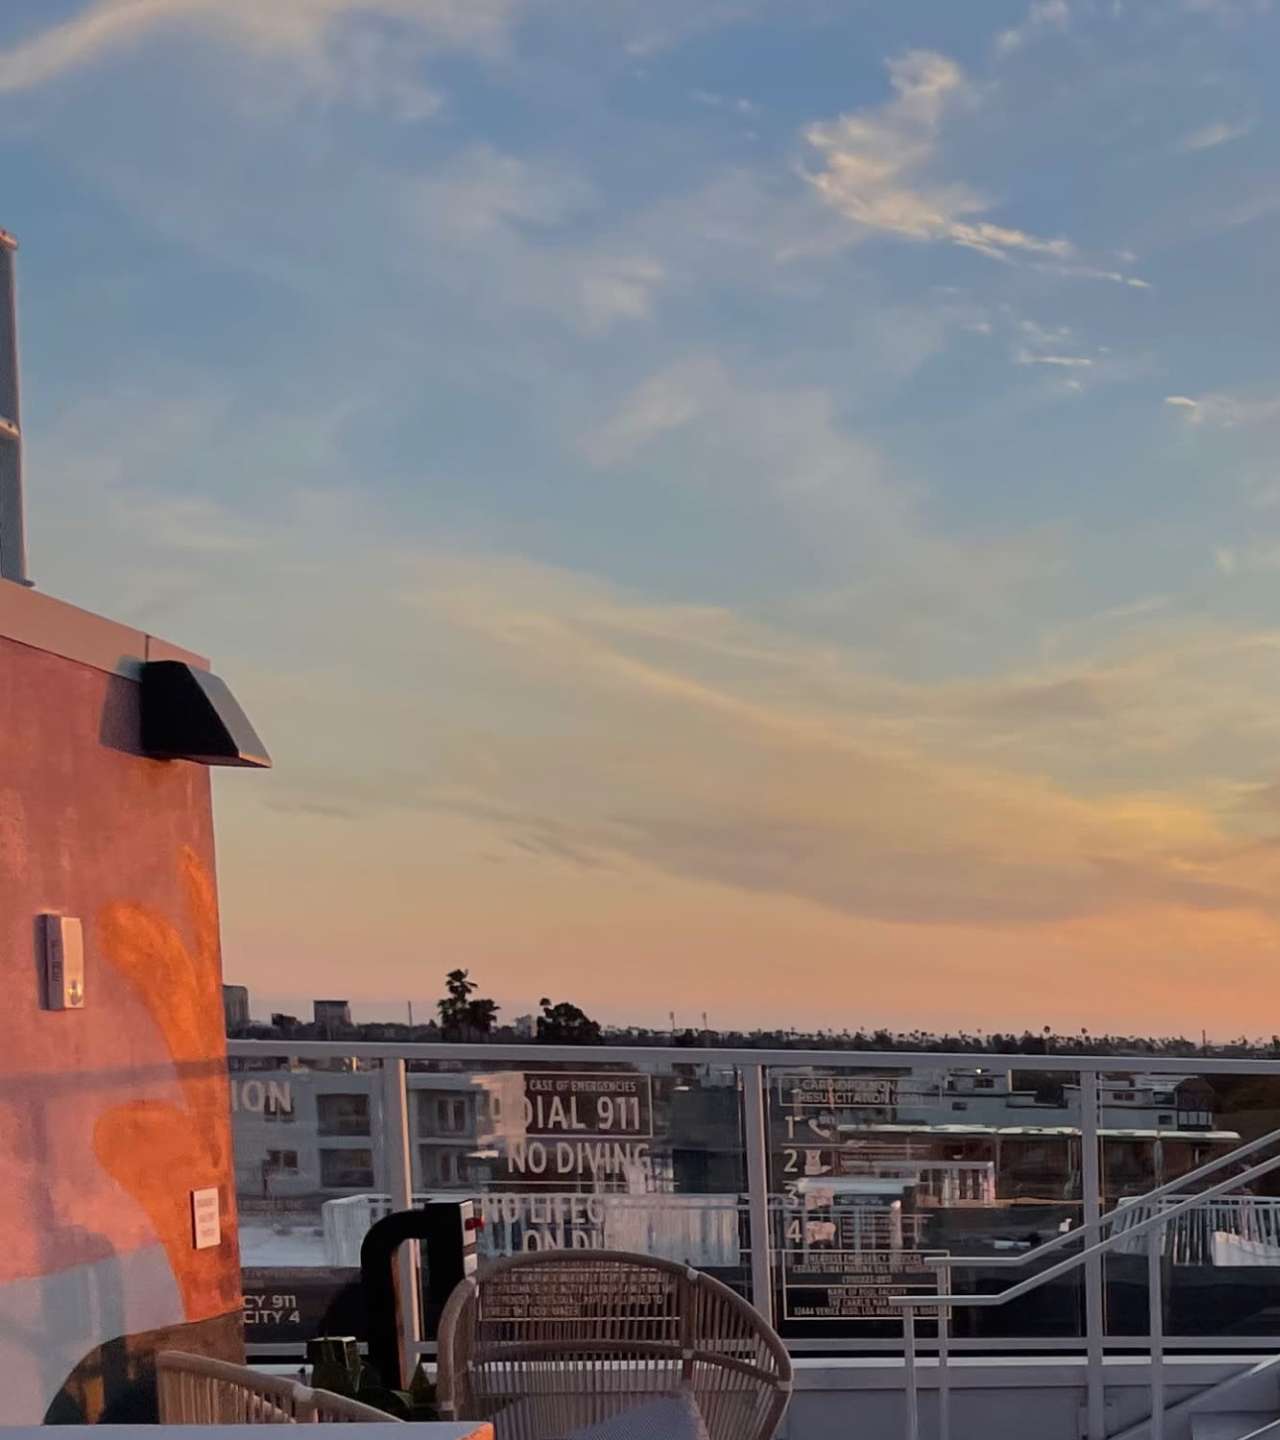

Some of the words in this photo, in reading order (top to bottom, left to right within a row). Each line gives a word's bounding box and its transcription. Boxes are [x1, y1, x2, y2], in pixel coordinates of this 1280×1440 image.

[231, 1079, 292, 1113] ION
[529, 1079, 553, 1092] CASE
[555, 1080, 570, 1092] OF
[571, 1080, 638, 1093] EMERGENCIES
[597, 1095, 641, 1131] 911
[507, 1141, 548, 1175] NO
[556, 1142, 652, 1175] DIVING
[531, 1193, 605, 1224] LIFEG
[243, 1294, 266, 1309] CY
[271, 1294, 298, 1309] 911
[243, 1310, 285, 1325] CITY
